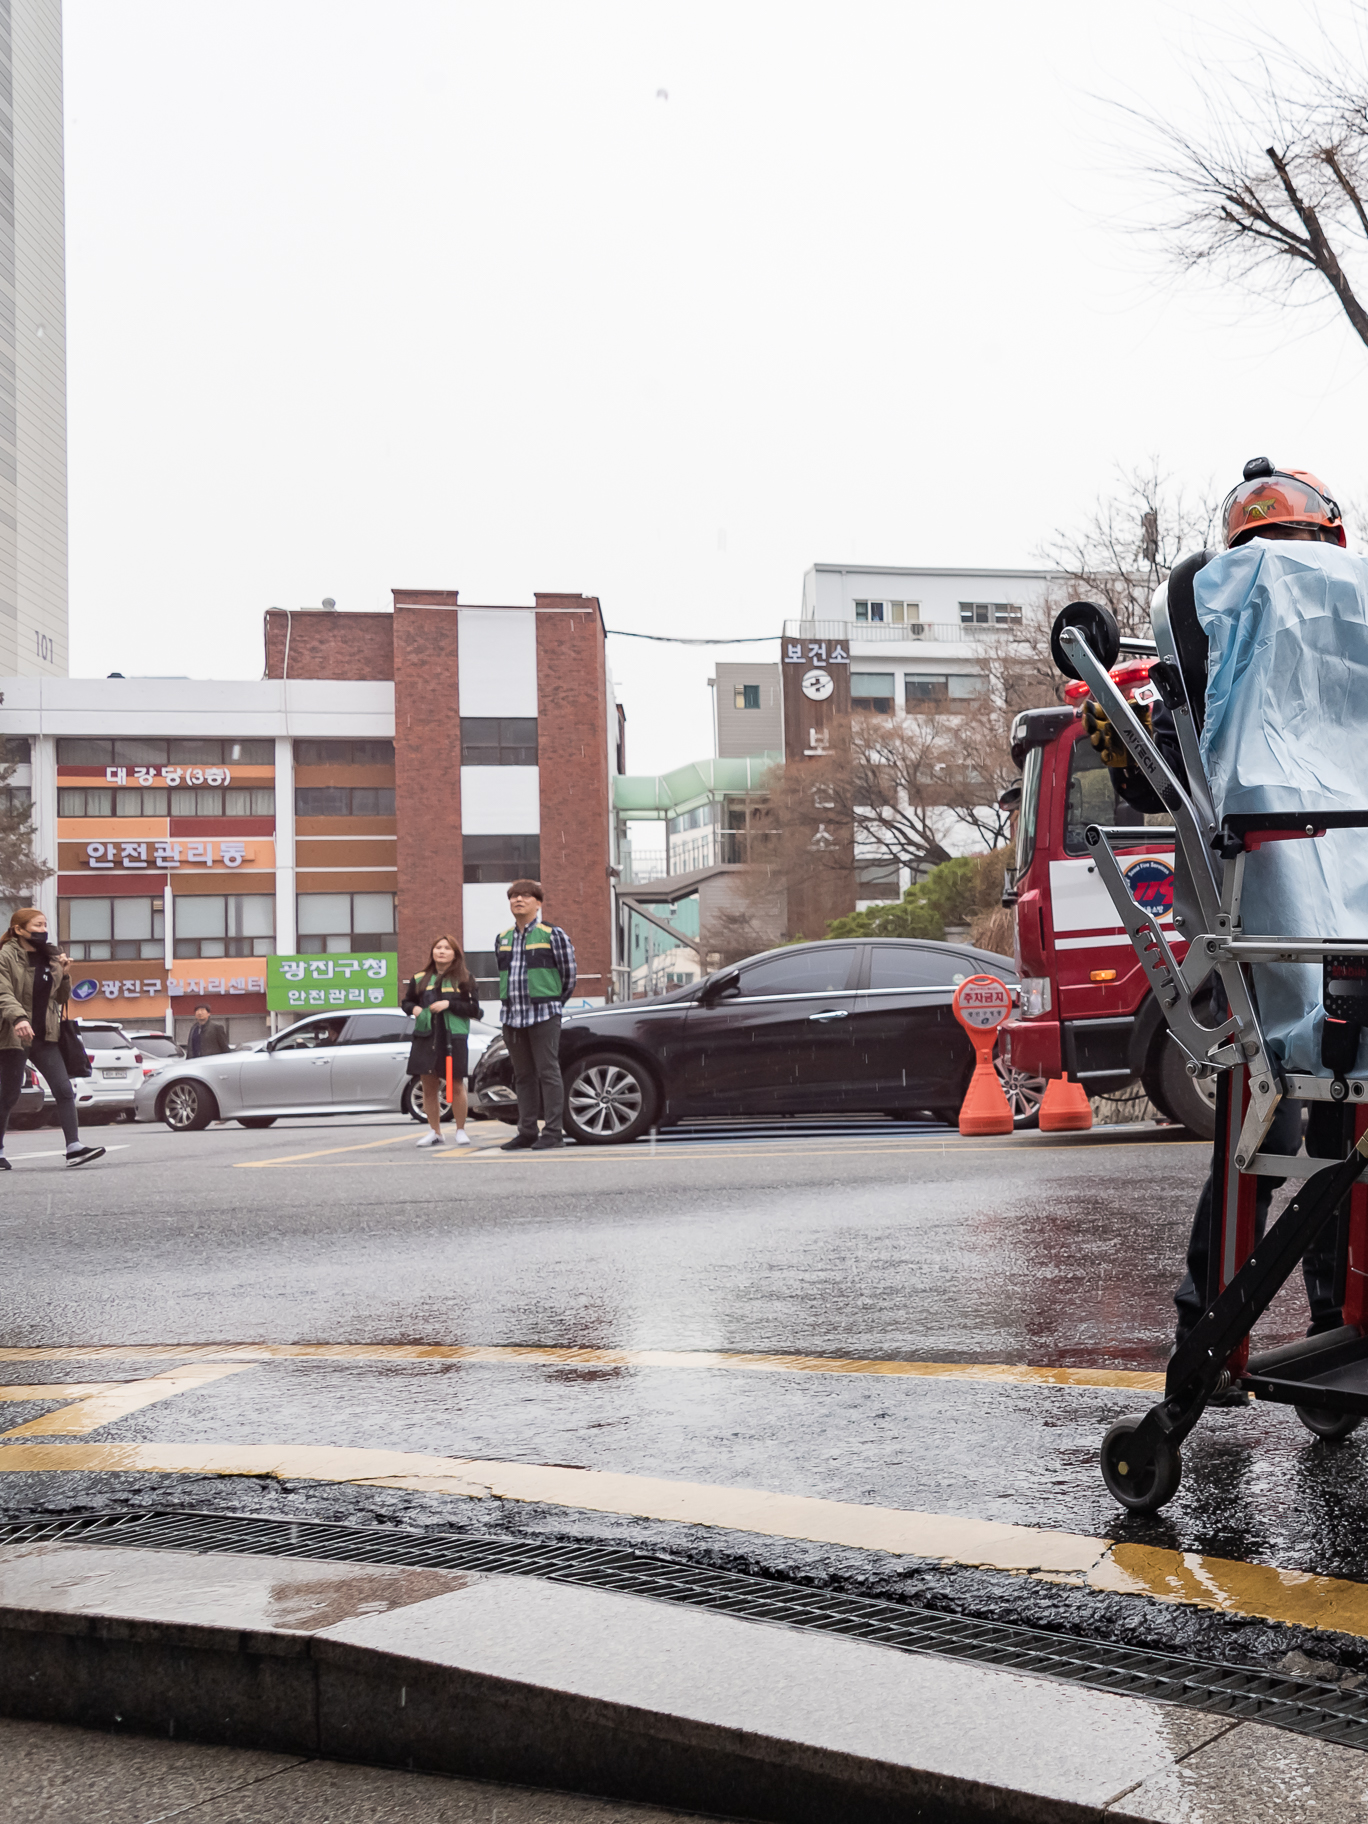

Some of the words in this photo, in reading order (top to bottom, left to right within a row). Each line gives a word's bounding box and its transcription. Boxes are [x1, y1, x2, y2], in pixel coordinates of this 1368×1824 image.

[35, 630, 53, 664] 101
[784, 642, 850, 667] 보건소
[1123, 730, 1156, 773] AUTECH
[86, 842, 246, 868] 안전관리동
[1143, 905, 1164, 914] 울소방
[279, 957, 387, 981] 광진구청
[1332, 965, 1367, 977] Mobile
[288, 987, 385, 1006] 안전관리동
